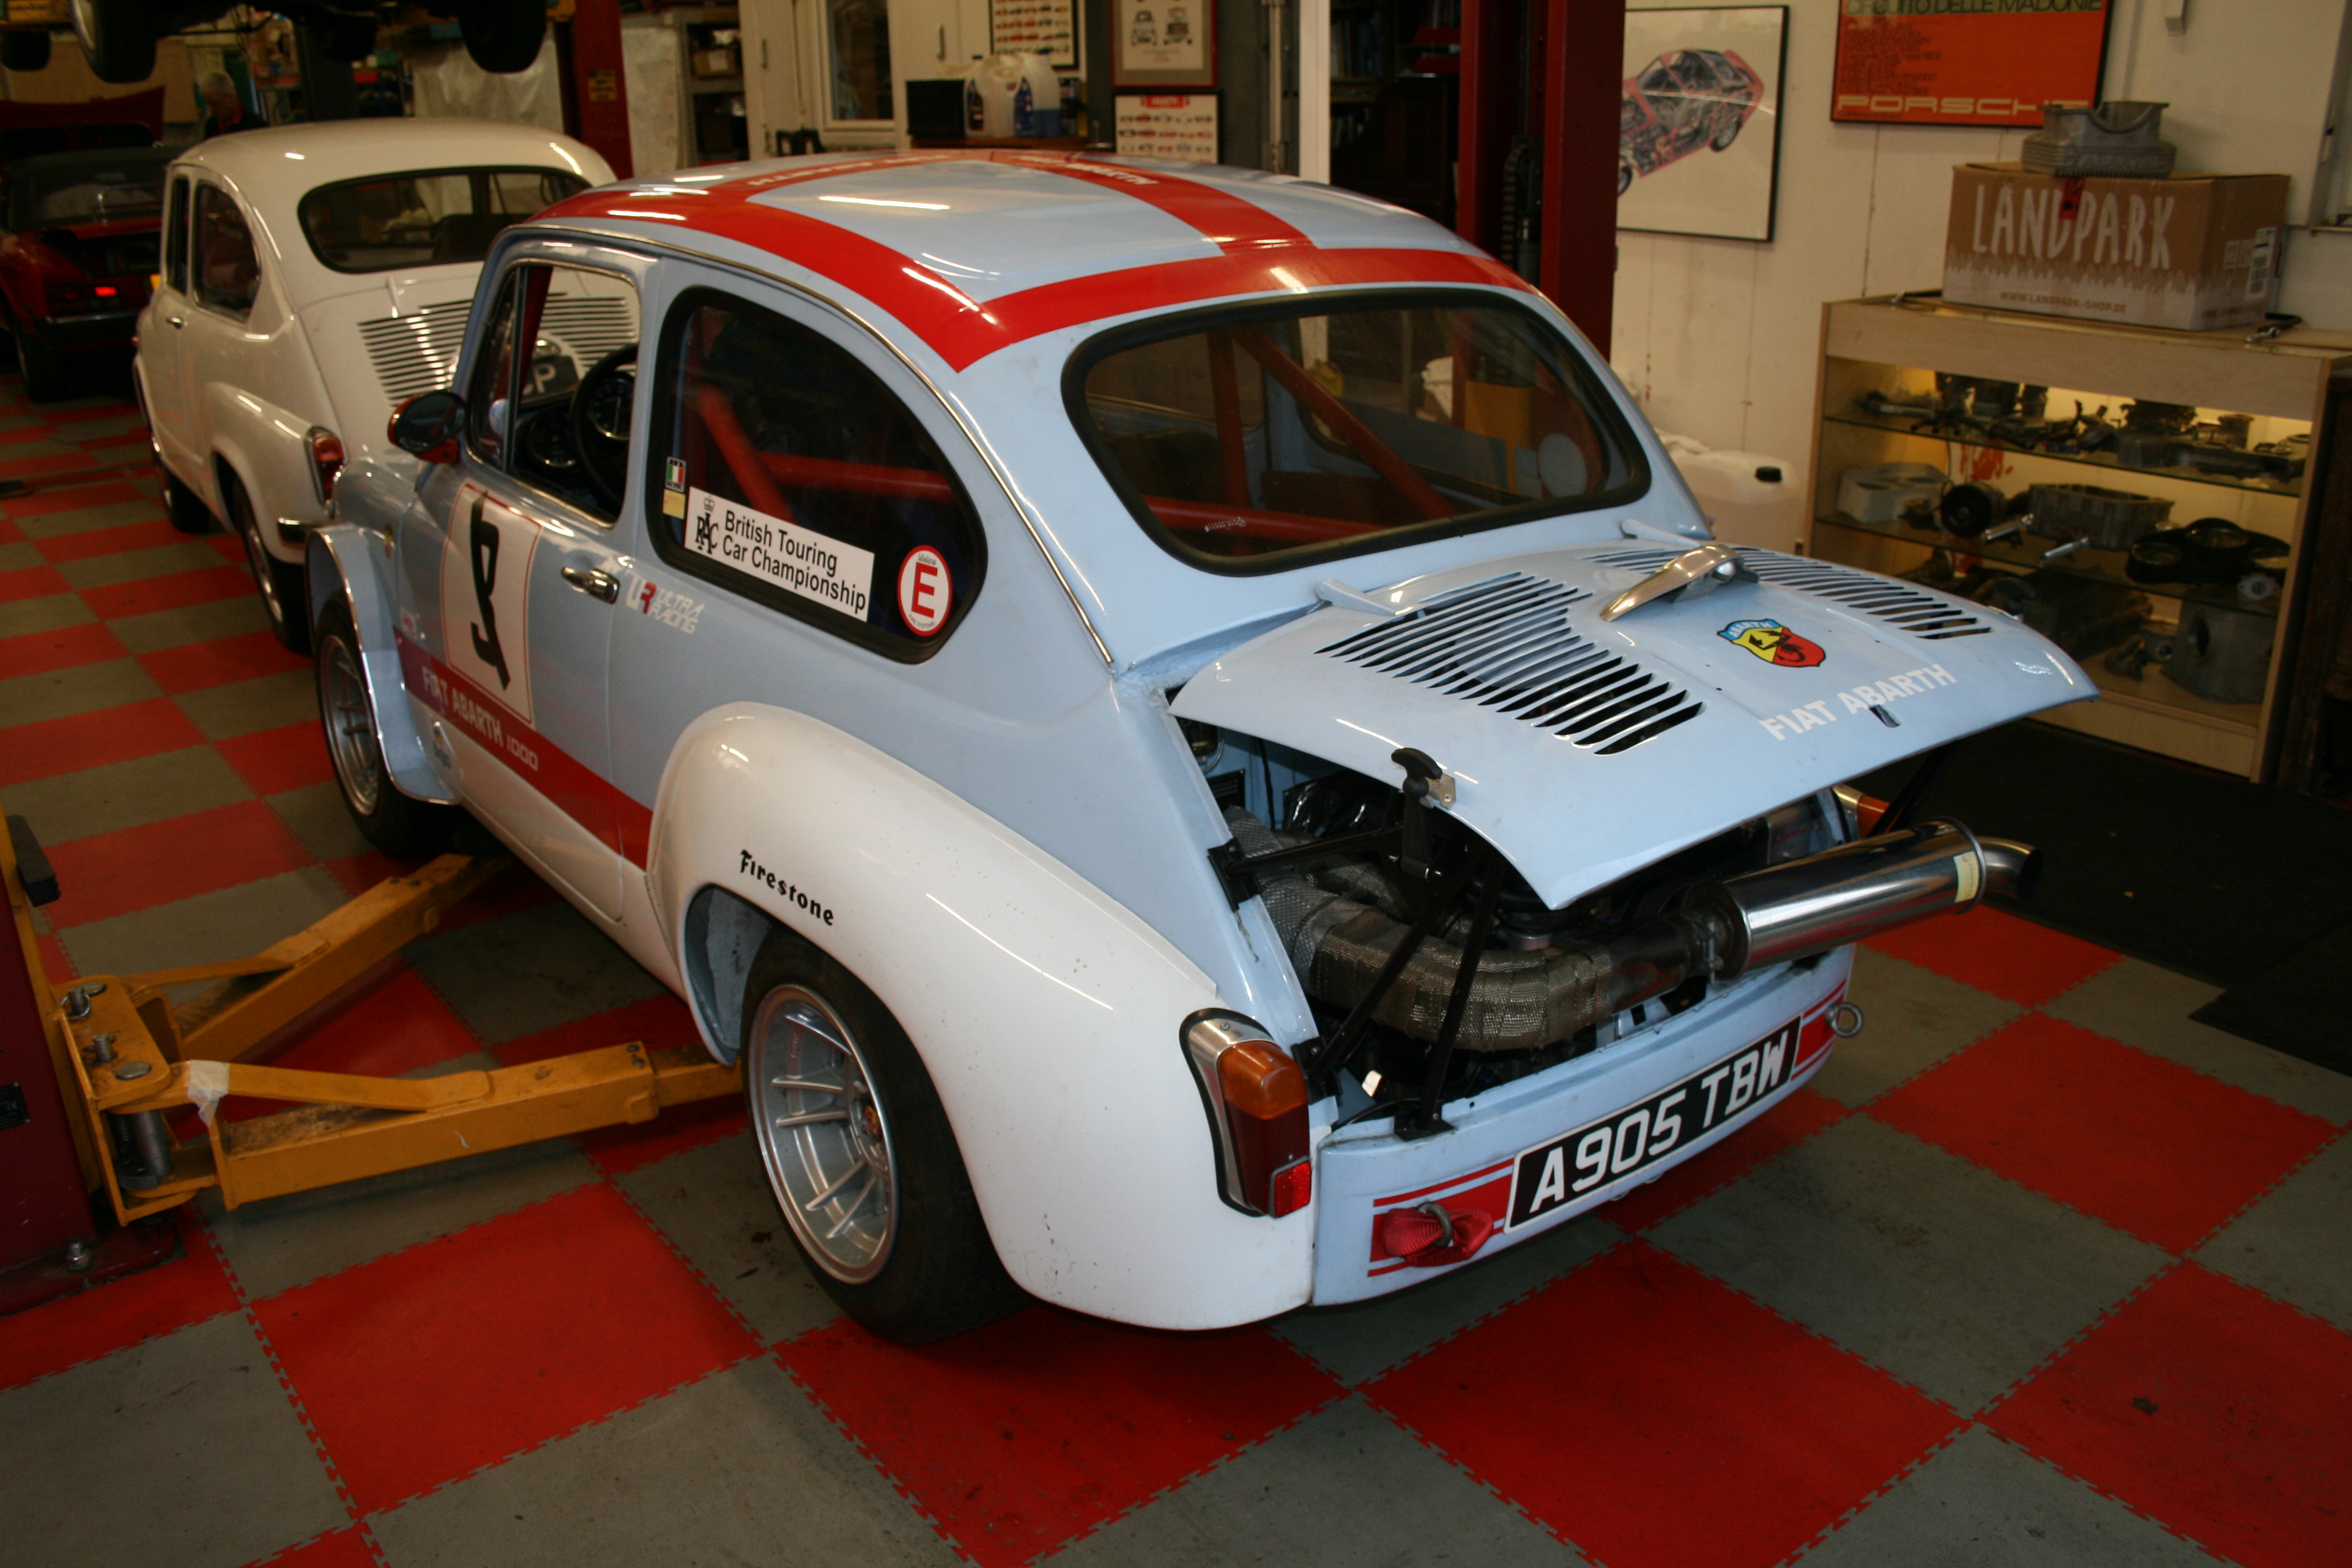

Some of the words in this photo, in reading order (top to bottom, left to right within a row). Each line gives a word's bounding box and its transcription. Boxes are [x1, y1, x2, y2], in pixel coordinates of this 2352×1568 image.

[1837, 95, 2089, 116] PORSCH
[1973, 184, 2174, 270] LANDPARK
[722, 534, 748, 563] Car
[751, 546, 866, 615] Championship
[725, 510, 772, 547] British
[778, 529, 837, 577] Touring
[655, 588, 705, 619] ULTRA
[911, 561, 938, 619] E
[1728, 621, 1773, 639] ABARTH
[451, 687, 505, 749] ABARTH
[506, 734, 540, 772] 1000
[1759, 700, 1837, 742] FIAT
[1837, 664, 1958, 715] ABARTH
[740, 849, 834, 927] Firestone
[1529, 1089, 1687, 1213] A905
[1700, 1030, 1789, 1129] TBW
